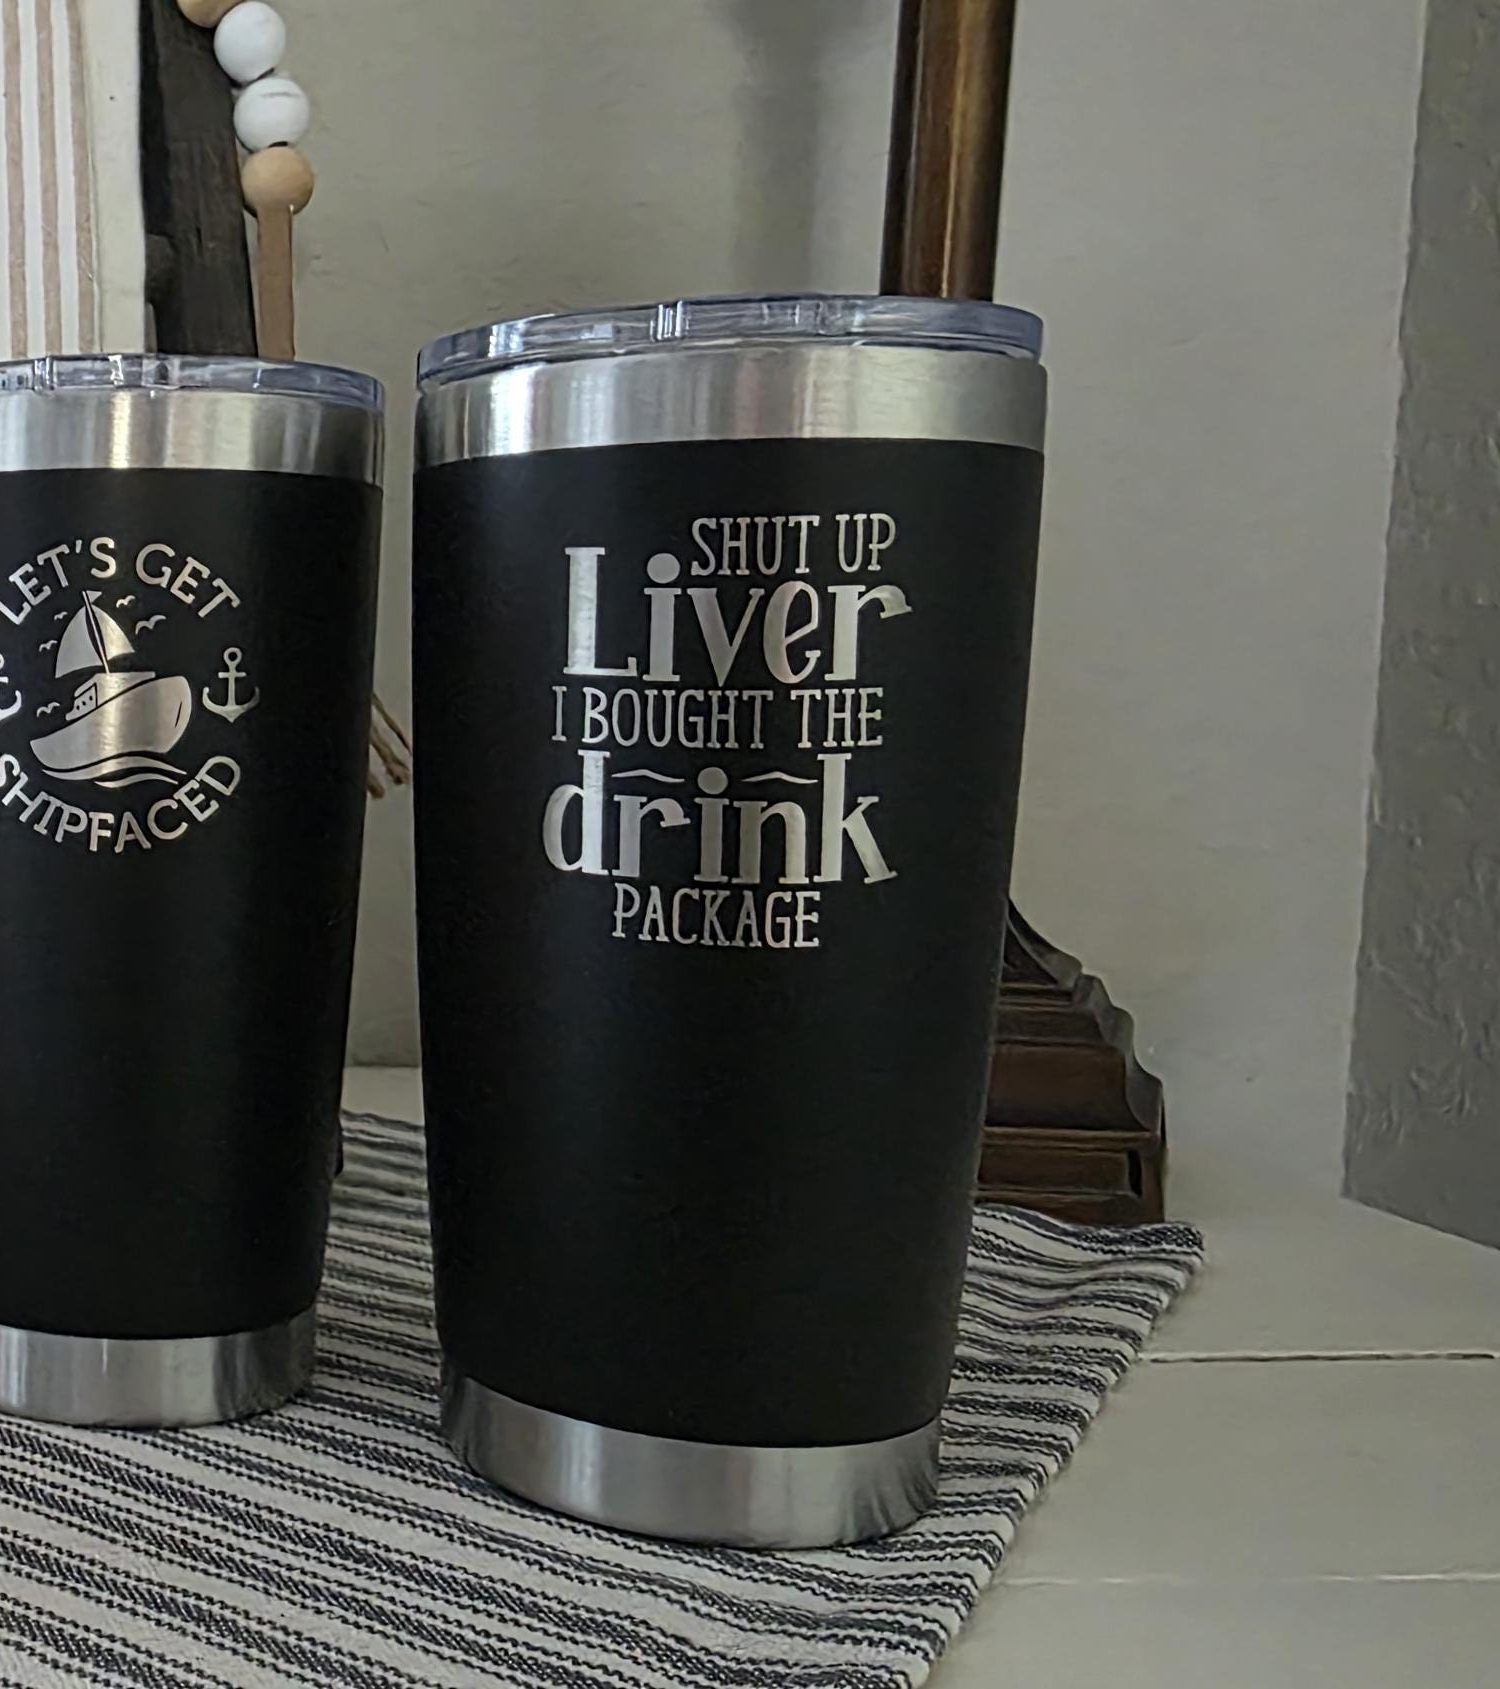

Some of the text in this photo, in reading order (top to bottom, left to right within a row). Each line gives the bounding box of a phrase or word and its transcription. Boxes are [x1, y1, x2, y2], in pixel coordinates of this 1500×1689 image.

[690, 512, 897, 576] SHUT UP
[136, 543, 241, 618] GET
[563, 546, 912, 686] Liver
[551, 685, 884, 749] I BOUGHT THE
[542, 749, 898, 885] drink
[612, 882, 822, 949] PACKAGE
